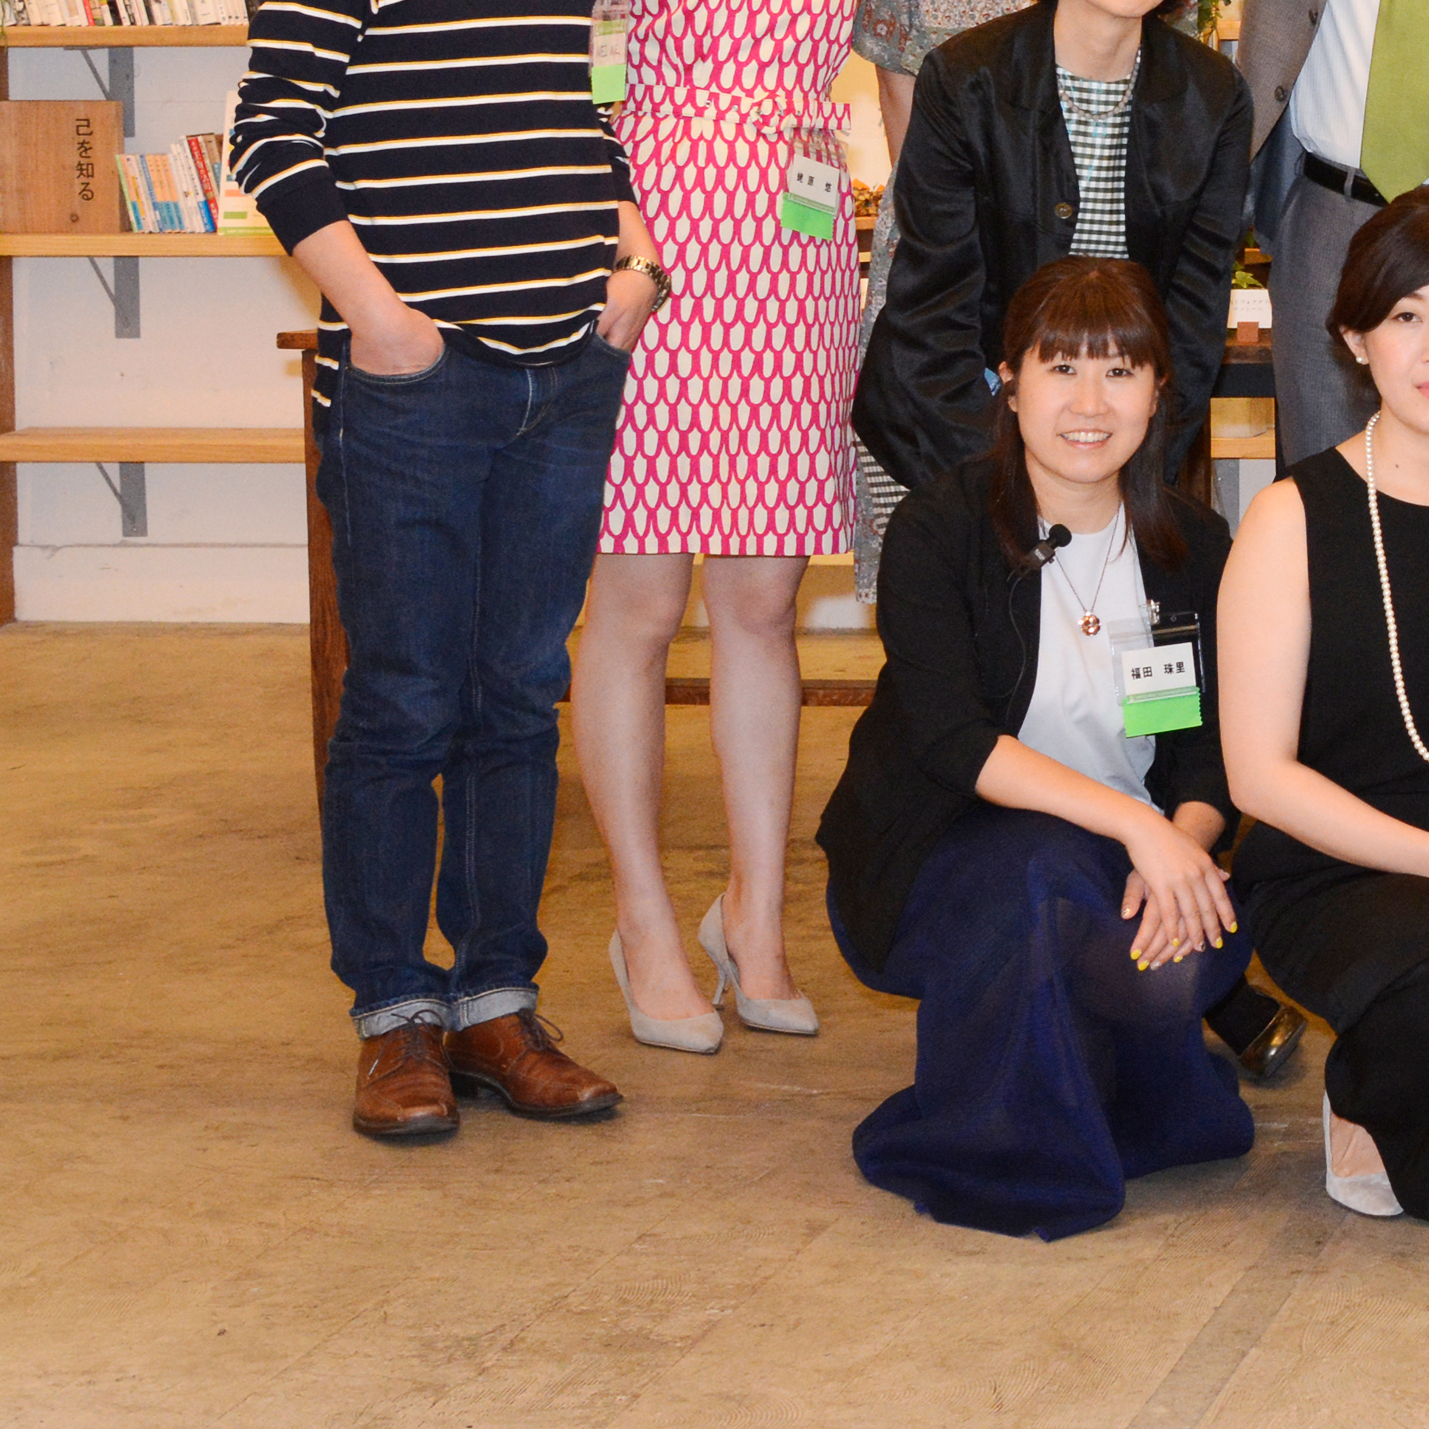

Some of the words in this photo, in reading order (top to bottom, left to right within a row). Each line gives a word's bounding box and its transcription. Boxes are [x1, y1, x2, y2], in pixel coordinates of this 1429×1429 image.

[75, 118, 95, 201] 己を知る
[1131, 666, 1153, 680] 福田
